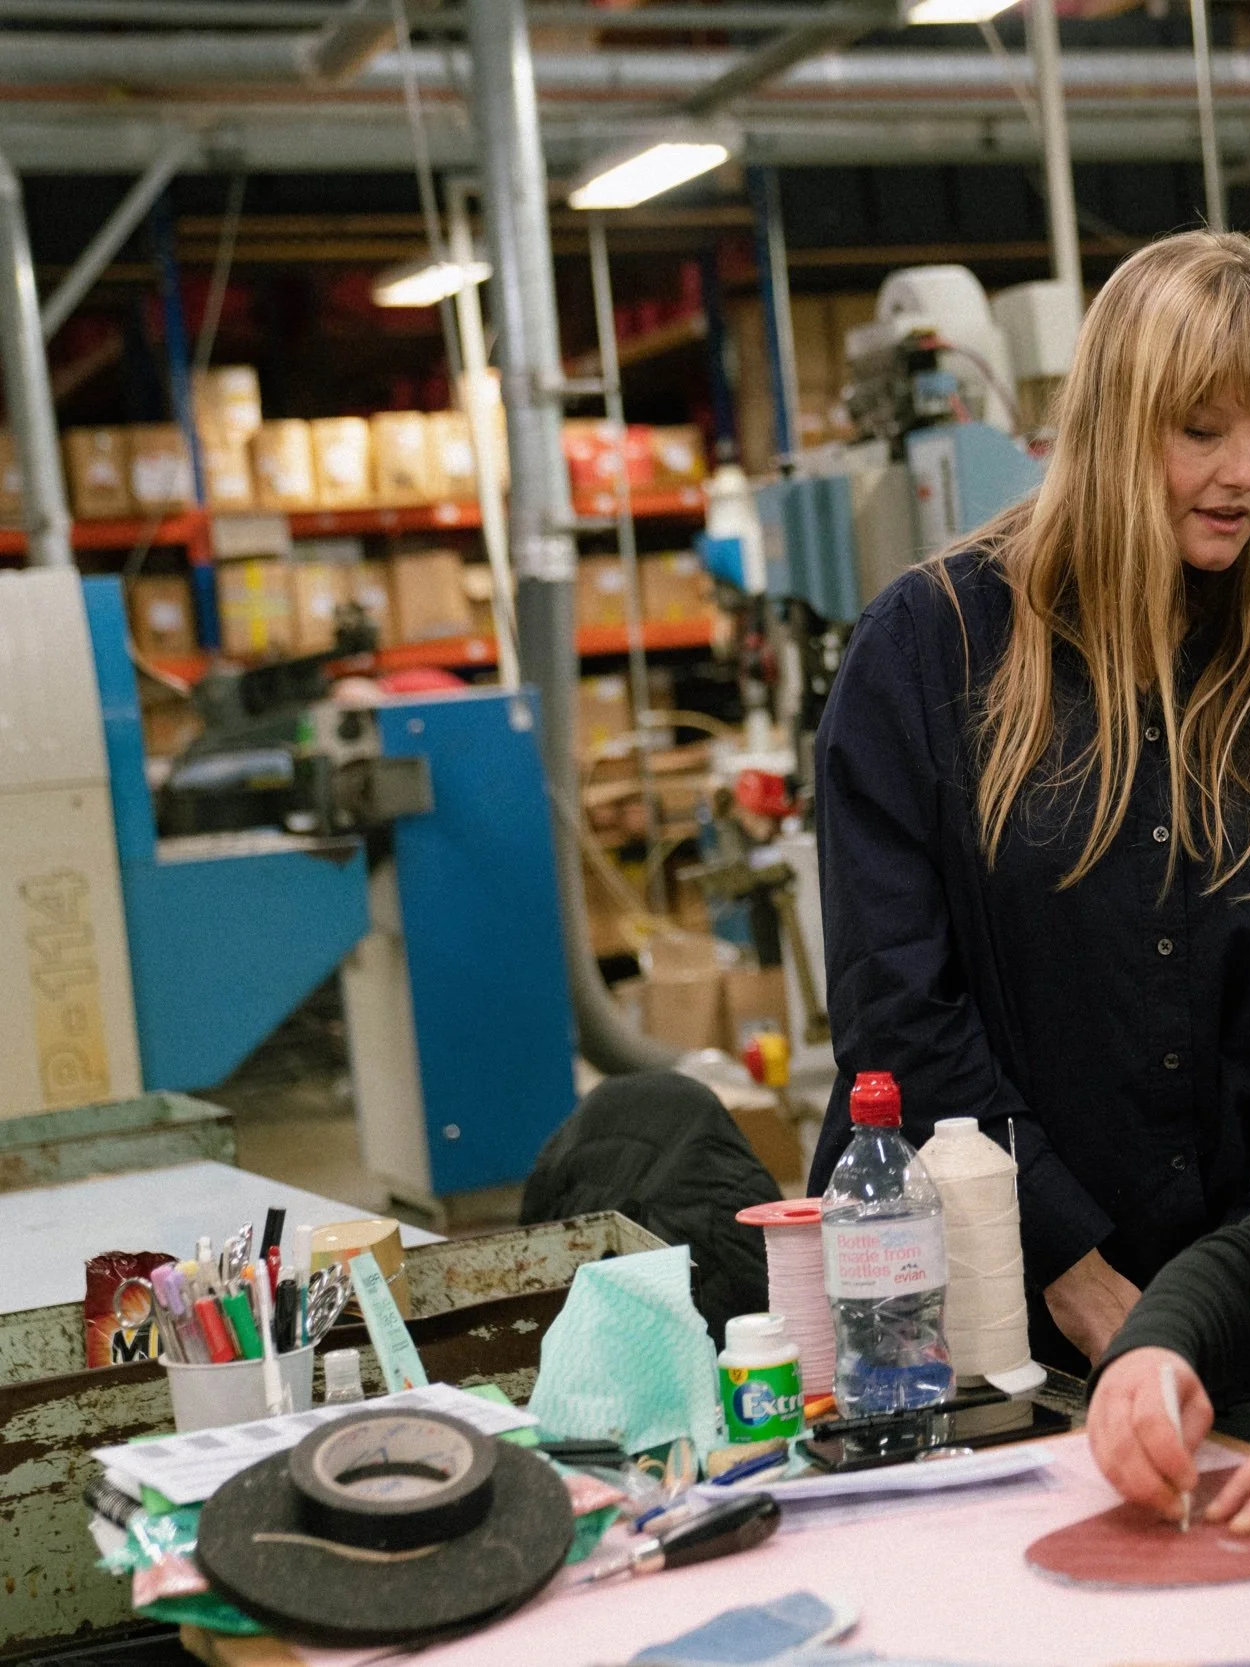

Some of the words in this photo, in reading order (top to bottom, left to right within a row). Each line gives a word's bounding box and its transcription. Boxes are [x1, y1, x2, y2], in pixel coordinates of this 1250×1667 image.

[837, 1234, 880, 1249] Bottle
[839, 1249, 879, 1263] made
[884, 1246, 921, 1261] from
[839, 1264, 891, 1278] bottles
[894, 1269, 926, 1284] evian
